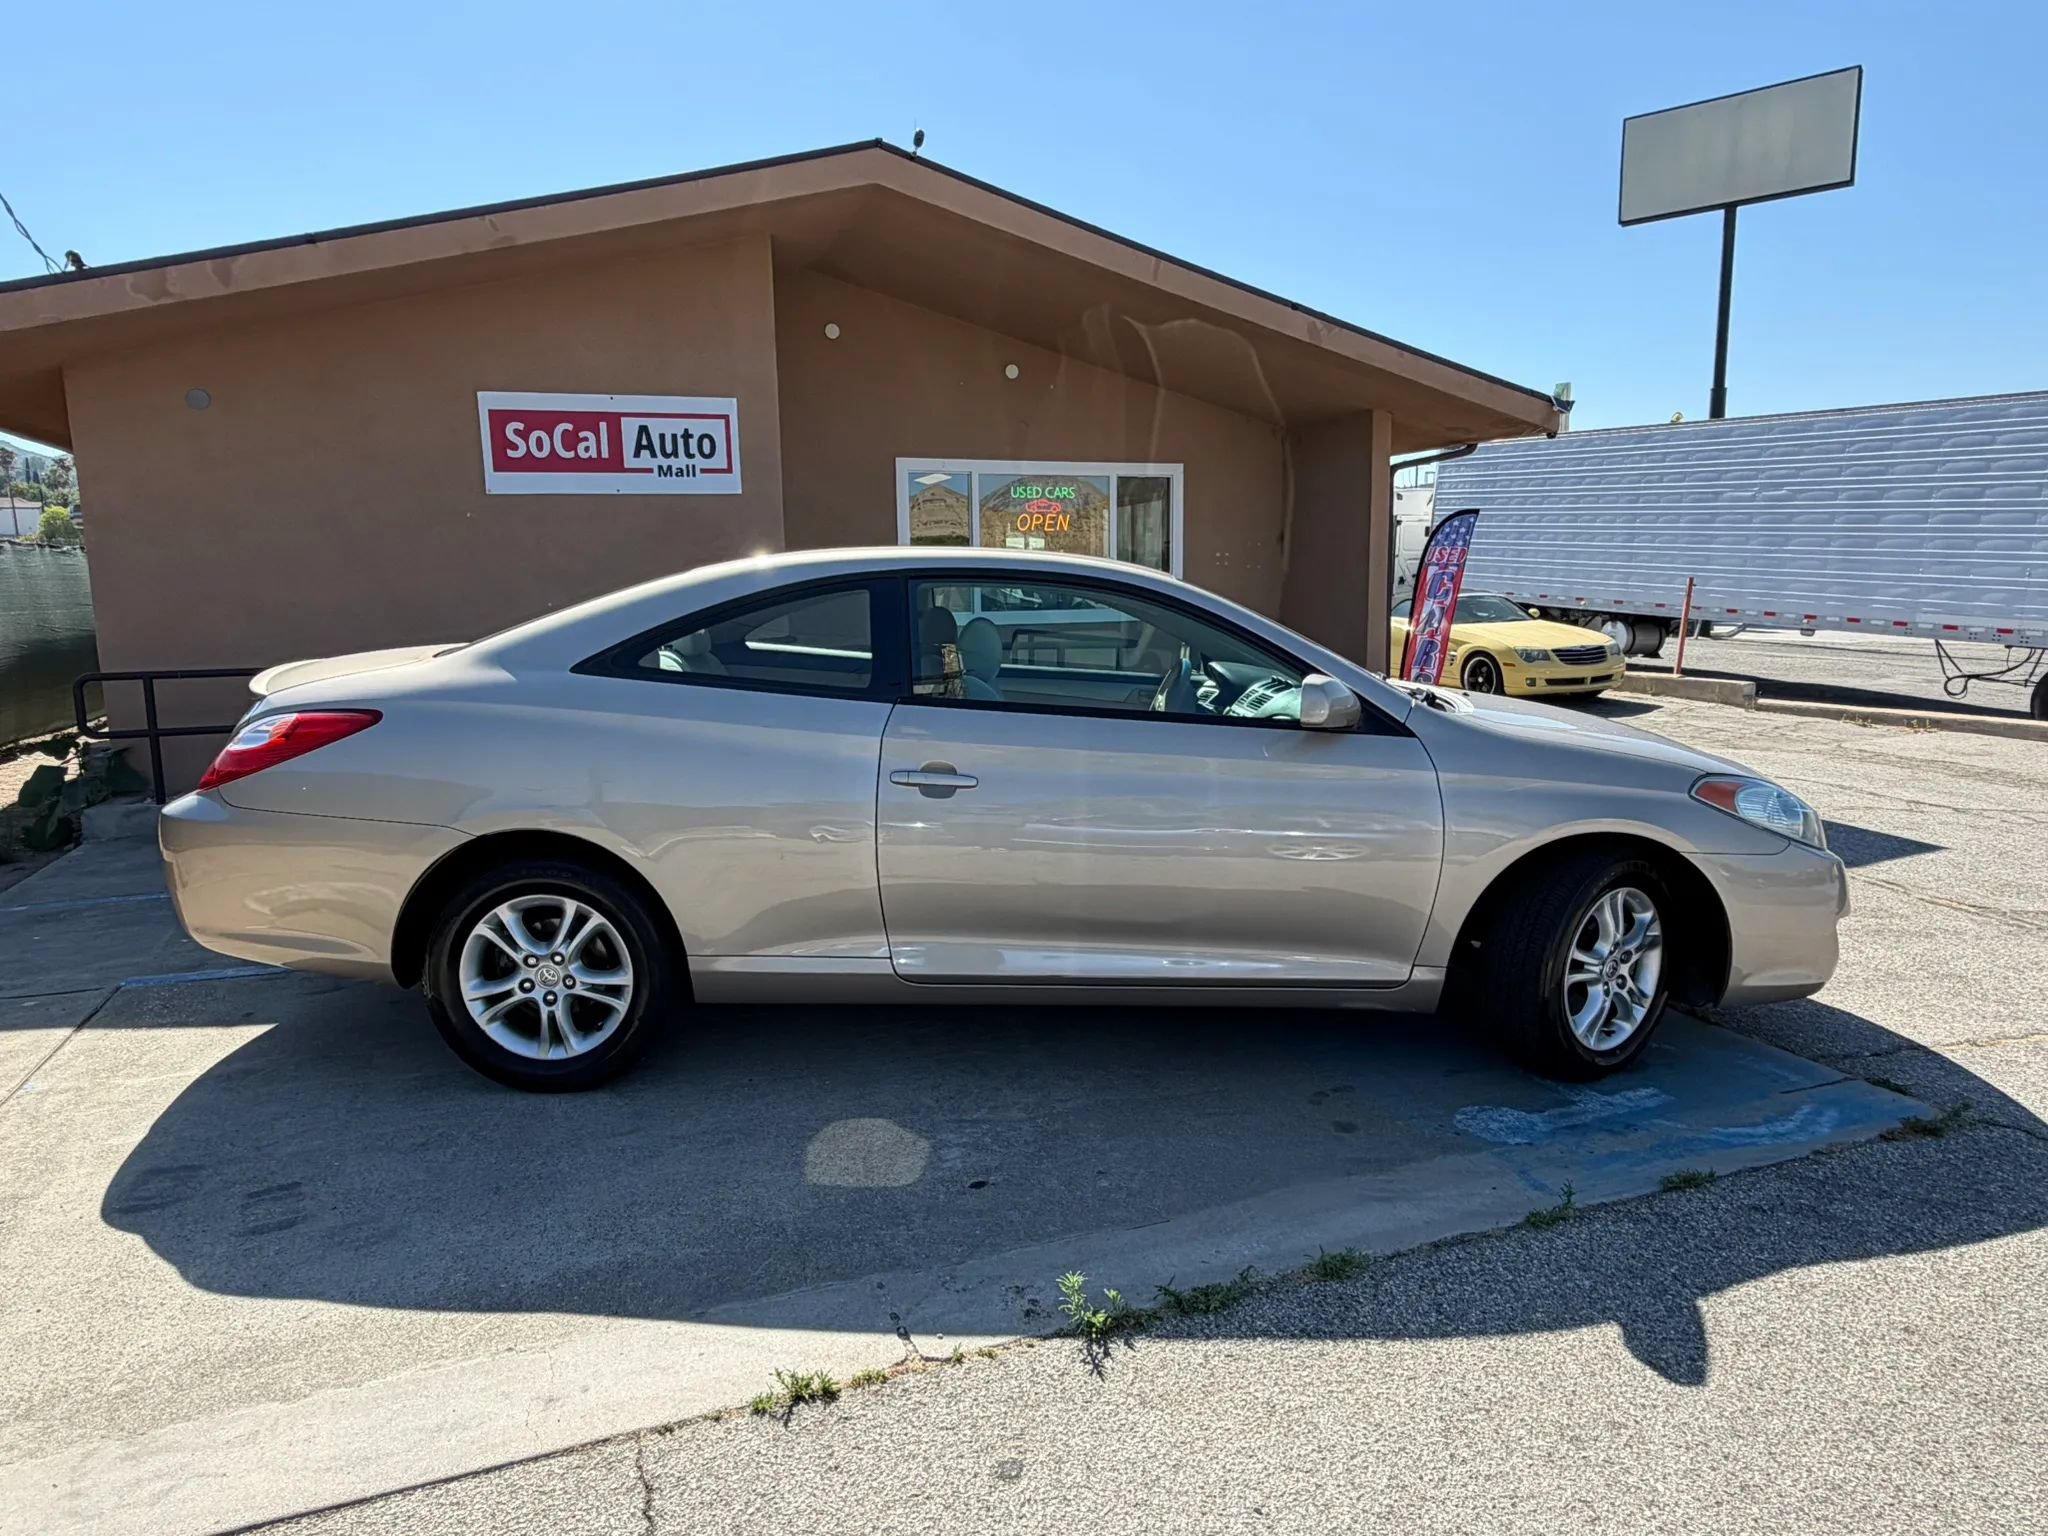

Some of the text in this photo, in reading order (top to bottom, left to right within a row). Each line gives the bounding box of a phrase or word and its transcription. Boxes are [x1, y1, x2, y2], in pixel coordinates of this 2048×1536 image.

[505, 421, 717, 459] SoCal Auto
[657, 464, 697, 478] Mall
[1011, 486, 1076, 499] USED CARS
[1017, 513, 1071, 532] OPEN
[1425, 546, 1468, 564] USED
